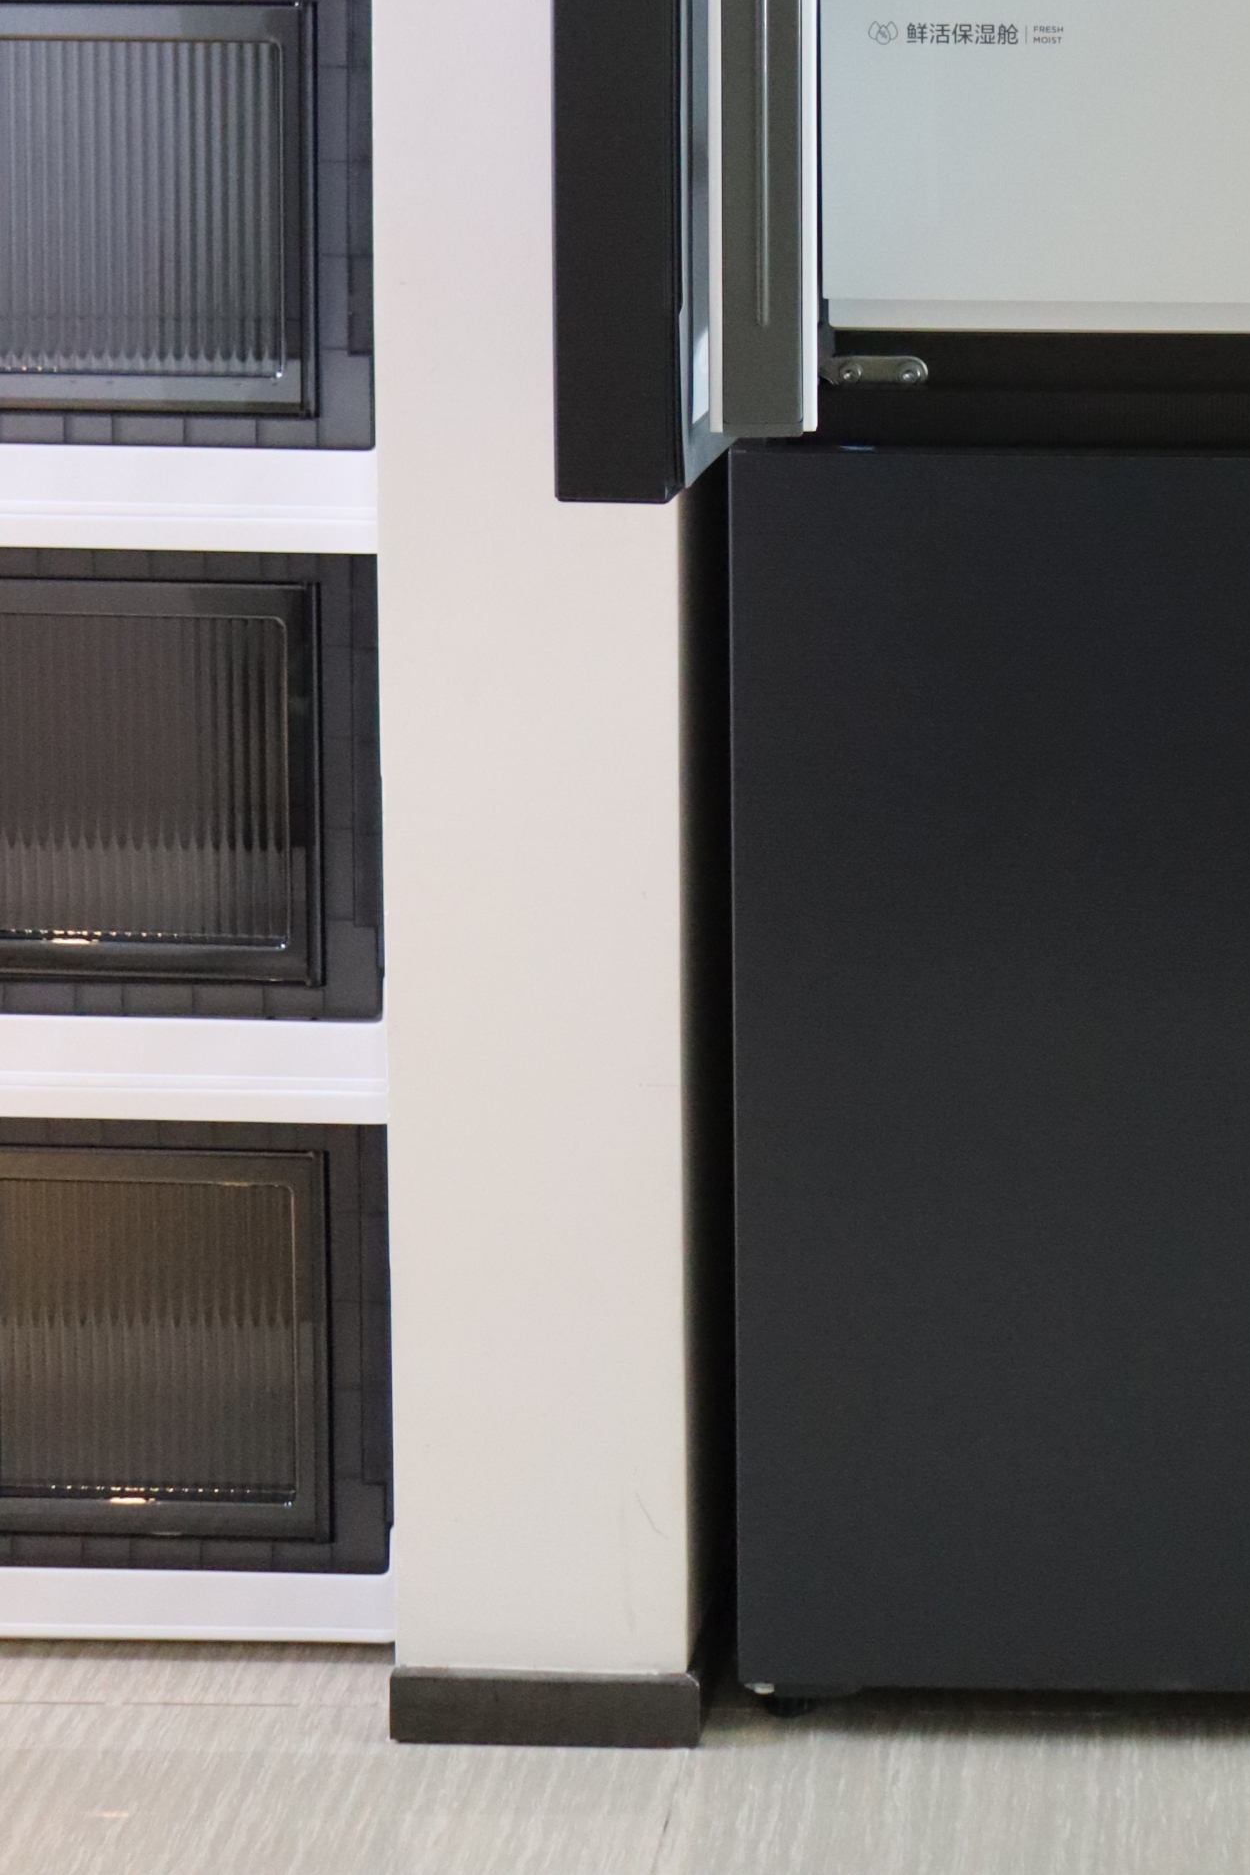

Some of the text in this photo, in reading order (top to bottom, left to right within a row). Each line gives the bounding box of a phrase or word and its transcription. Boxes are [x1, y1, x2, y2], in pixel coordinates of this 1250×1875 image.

[1033, 25, 1064, 33] FRESH
[906, 22, 1019, 45] 鲜活保湿舱
[1033, 36, 1062, 44] MOIST
